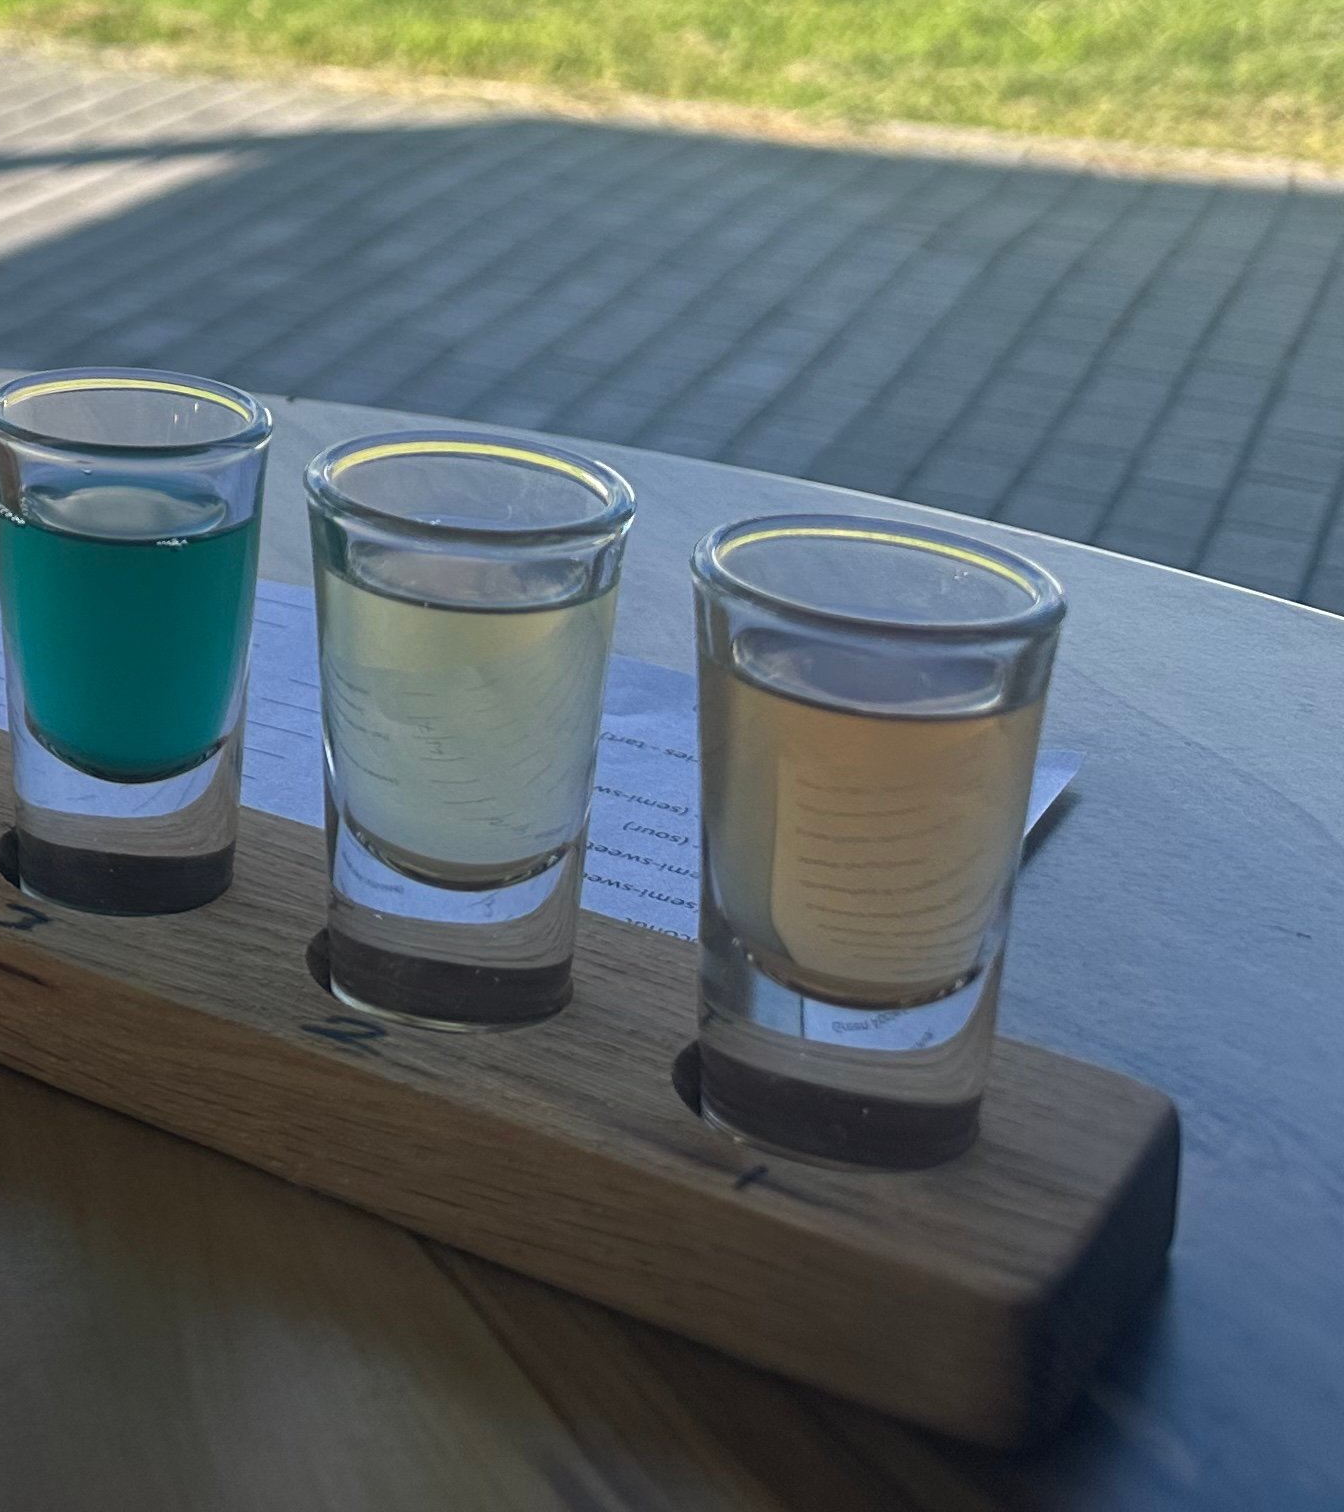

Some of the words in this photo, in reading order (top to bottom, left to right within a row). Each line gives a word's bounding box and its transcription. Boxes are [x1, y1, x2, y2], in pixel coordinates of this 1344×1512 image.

[594, 785, 689, 816] (semi-sw
[623, 821, 689, 846] (sour)
[585, 841, 700, 879] emi-sweet
[582, 872, 700, 914] semi-swe
[299, 1015, 388, 1057] 2
